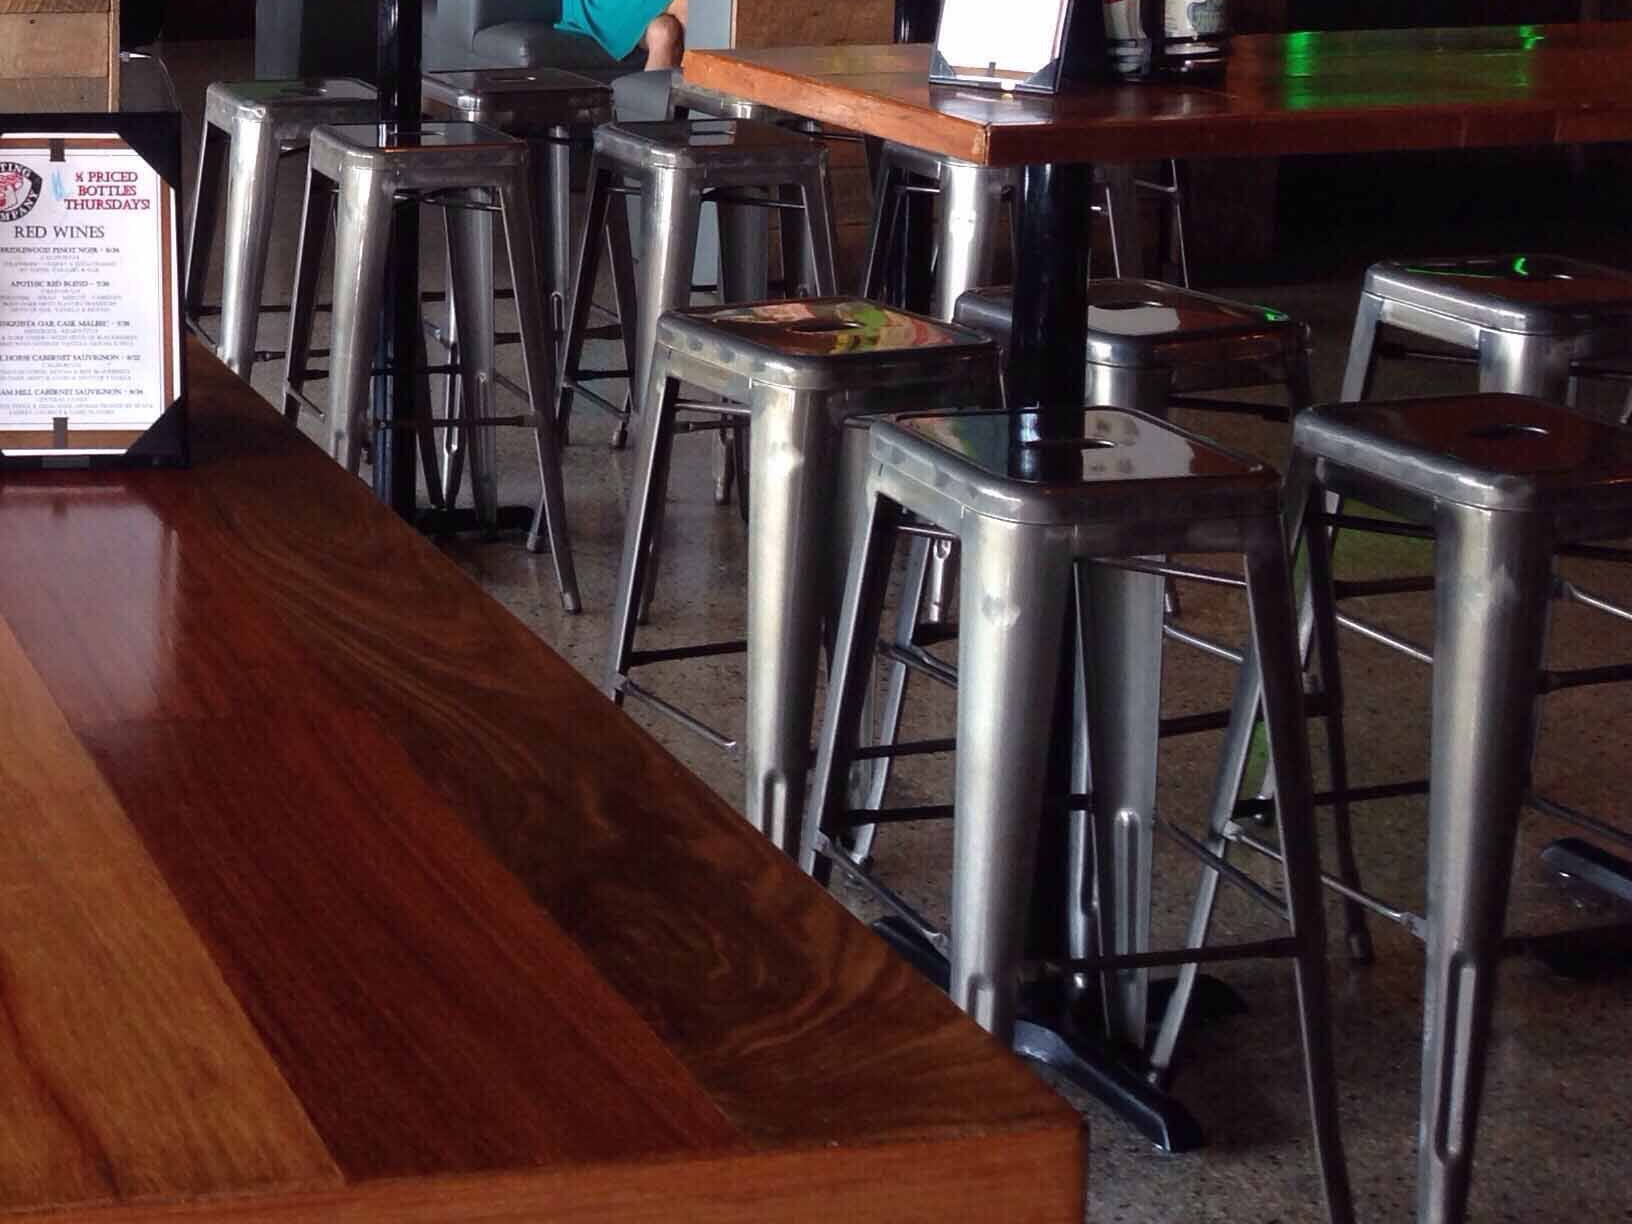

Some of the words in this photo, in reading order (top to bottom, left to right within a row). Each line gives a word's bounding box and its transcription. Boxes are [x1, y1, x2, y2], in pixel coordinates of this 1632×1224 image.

[88, 171, 138, 182] PRICED
[78, 185, 137, 196] BOTTLES
[64, 199, 150, 210] THURSDAYS!
[14, 225, 47, 238] RED
[53, 225, 105, 238] WINES
